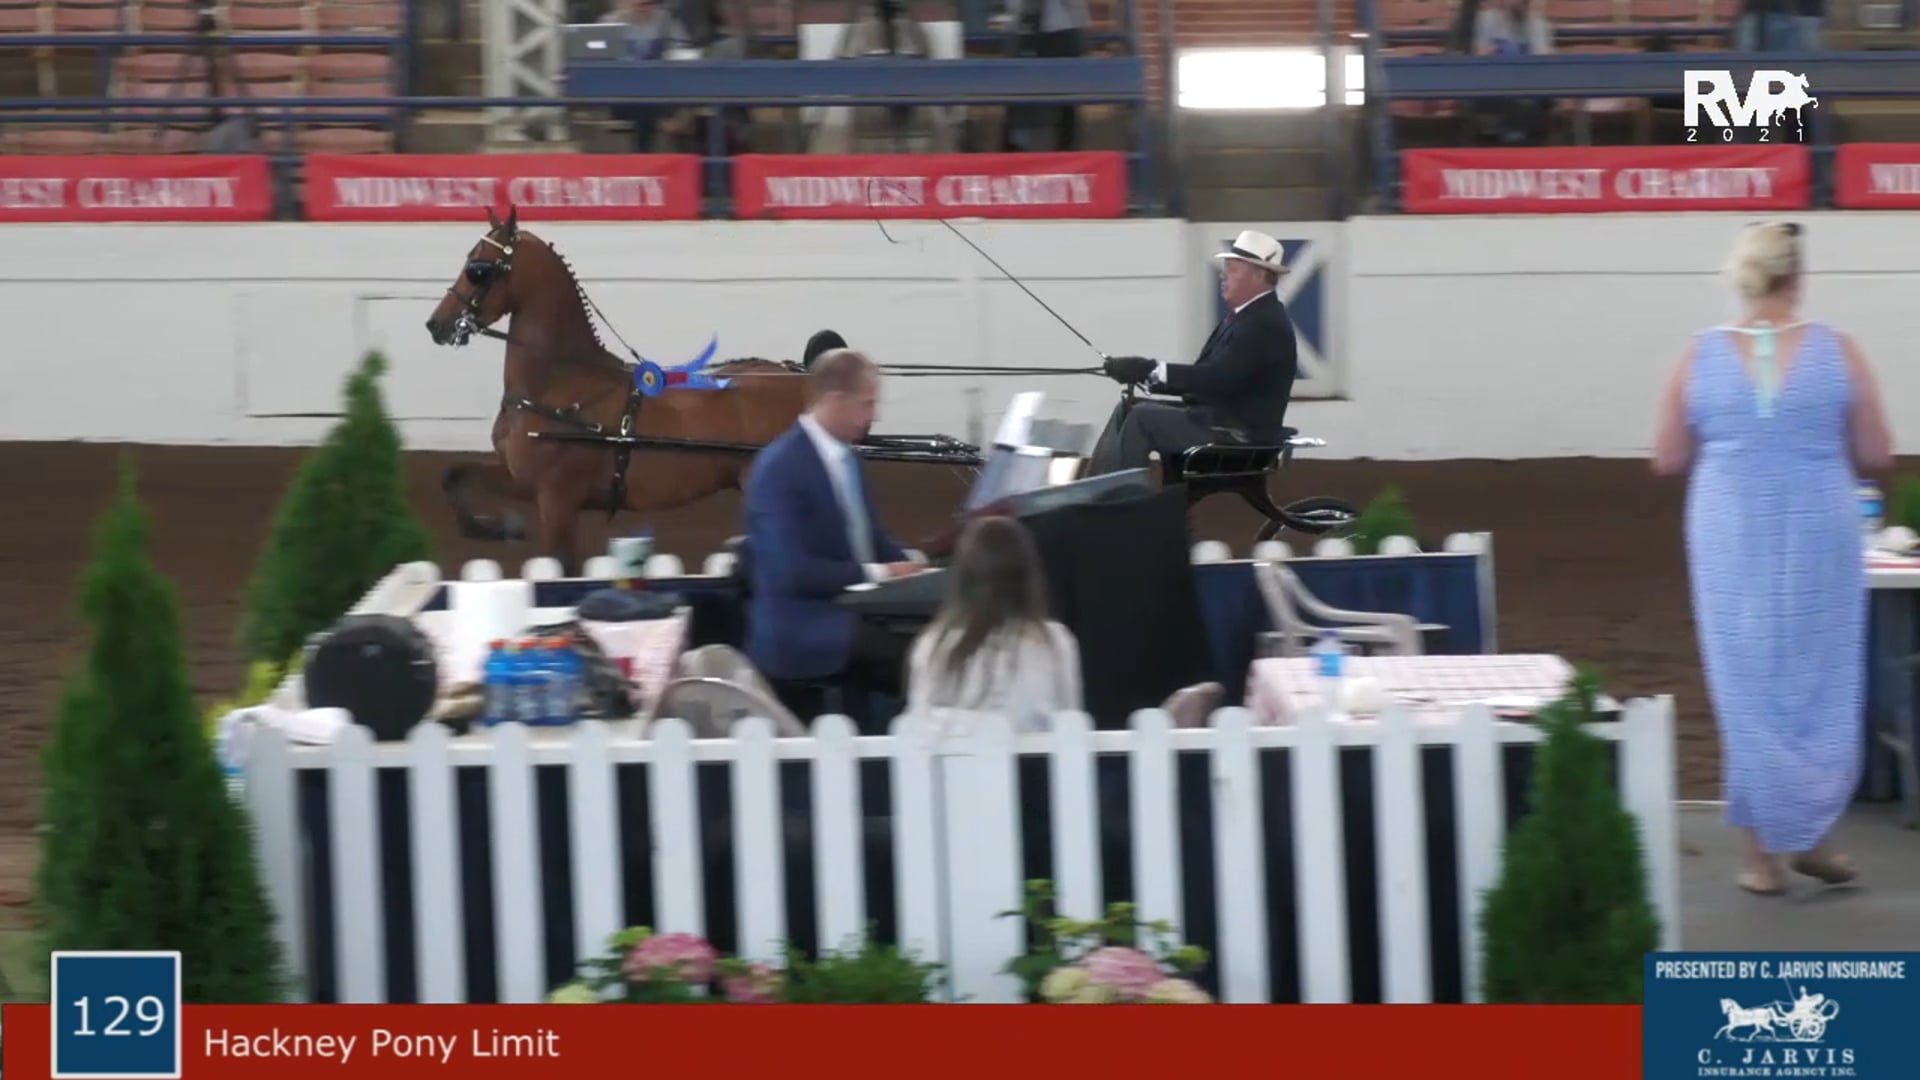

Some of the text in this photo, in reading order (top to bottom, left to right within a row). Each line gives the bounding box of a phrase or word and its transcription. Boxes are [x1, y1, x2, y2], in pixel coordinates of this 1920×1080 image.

[77, 177, 236, 208] CHARITY
[332, 177, 667, 208] MIDWEST CHARITY
[763, 174, 1096, 207] MIDWEST CHARITY
[1439, 167, 1780, 199] MIDWEST CHARITY
